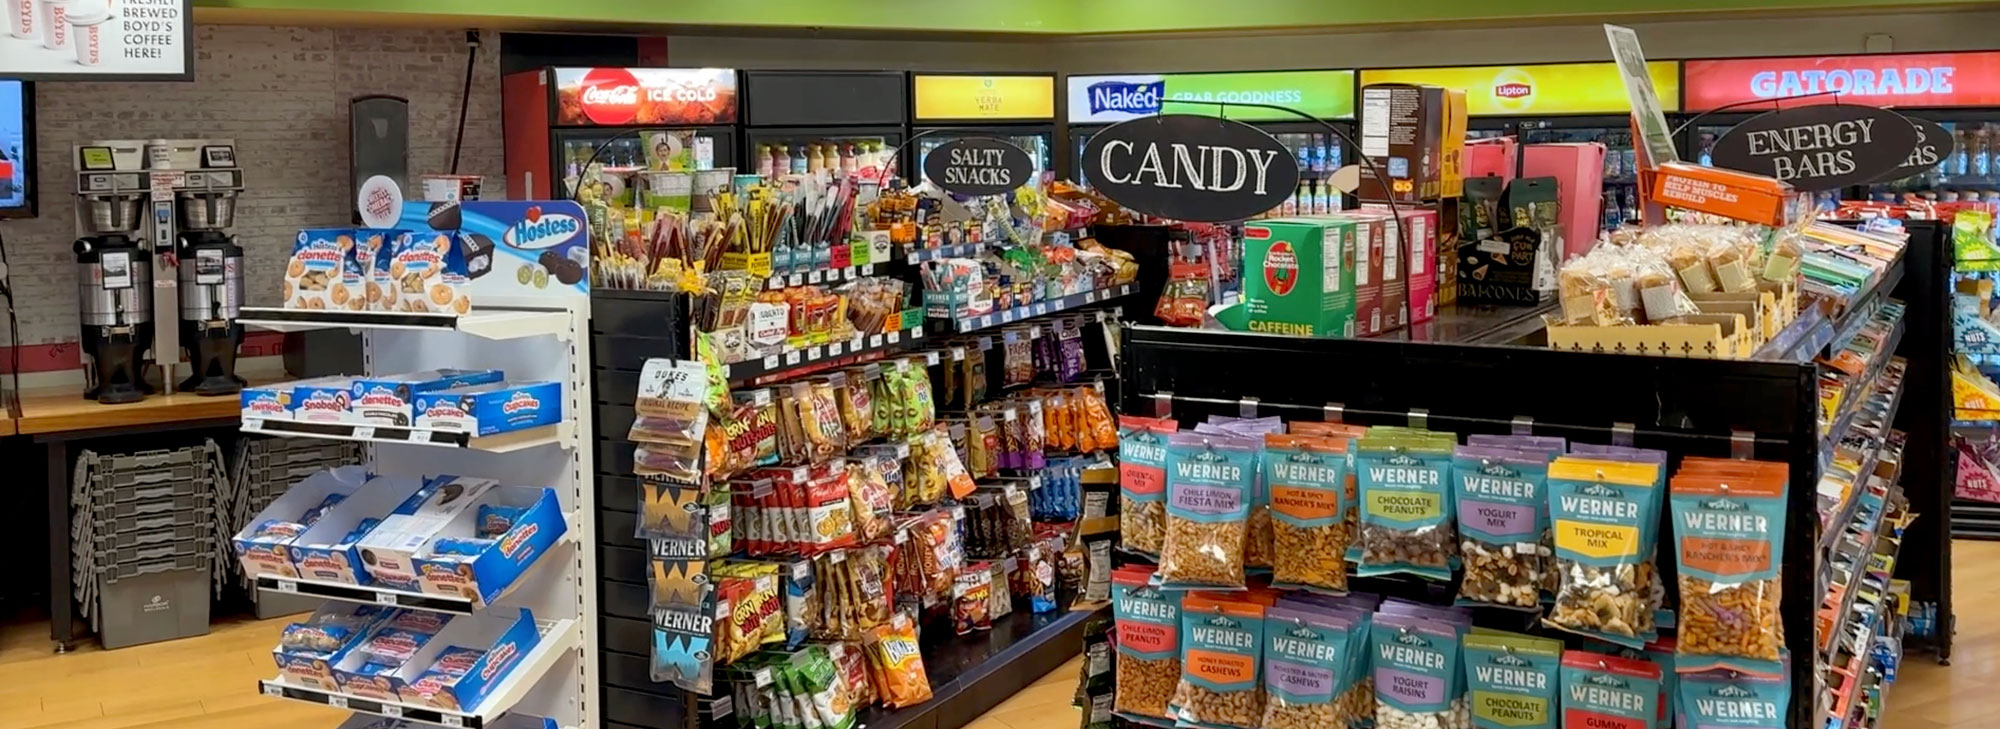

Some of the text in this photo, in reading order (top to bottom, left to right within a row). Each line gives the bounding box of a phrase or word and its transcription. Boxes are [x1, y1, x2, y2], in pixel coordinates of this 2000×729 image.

[20, 0, 33, 34] OYDS
[123, 8, 178, 18] BREWED
[124, 21, 173, 31] BOYD'S
[124, 34, 172, 45] COFFEE
[124, 48, 162, 58] HERE!
[1751, 67, 1954, 97] GATORADE
[648, 89, 716, 101] ICE COLD
[1095, 86, 1158, 109] Naked
[1219, 90, 1301, 103] GOODNESS
[1498, 85, 1529, 97] Lipton
[1747, 118, 1876, 156] ENERGY
[951, 148, 1005, 166] SALTY
[1773, 150, 1857, 181] BARS
[945, 167, 1011, 185] SNACKS
[1100, 140, 1278, 195] CANDY
[1664, 181, 1739, 202] HELP MUSCLES
[1712, 182, 1727, 191] TO
[1662, 188, 1706, 203] REBUILD
[513, 218, 577, 245] Hostess
[1249, 321, 1314, 336] CAFFEINE
[1965, 333, 1986, 342] NUTS
[1124, 442, 1167, 463] WERNER
[1177, 462, 1241, 481] WERNER
[1274, 463, 1336, 484] WERNER
[1370, 467, 1439, 486] WERNER
[1463, 476, 1534, 499] WERNER
[1179, 496, 1235, 510] FIESTA MIX
[1377, 495, 1432, 508] CHOCOLATE
[1383, 504, 1427, 516] PEANUTS
[1560, 496, 1638, 518] WERNER
[1477, 508, 1517, 520] YOGURT
[1685, 512, 1768, 533] WERNER
[1487, 518, 1507, 529] MIX
[1574, 527, 1624, 541] TROPICAL
[651, 539, 706, 556] WERNER
[1587, 539, 1608, 549] MIX
[1120, 599, 1176, 619] WERNER
[655, 608, 712, 633] WERNER
[1126, 632, 1161, 645] PEANUTS
[1192, 628, 1253, 648] WERNER
[1273, 637, 1336, 661] WERNER
[1379, 644, 1445, 669] WERNER
[1200, 664, 1241, 676] CASHEWS
[1476, 666, 1547, 689] WERNER
[1280, 674, 1320, 688] CASHEWS
[1393, 676, 1428, 689] YOGURT
[1392, 685, 1426, 699] RAISINS
[1569, 685, 1644, 711] WERNER
[1486, 698, 1540, 712] CHOCOLATE
[1696, 699, 1777, 719] WERNER
[1491, 708, 1535, 721] PEANUTS
